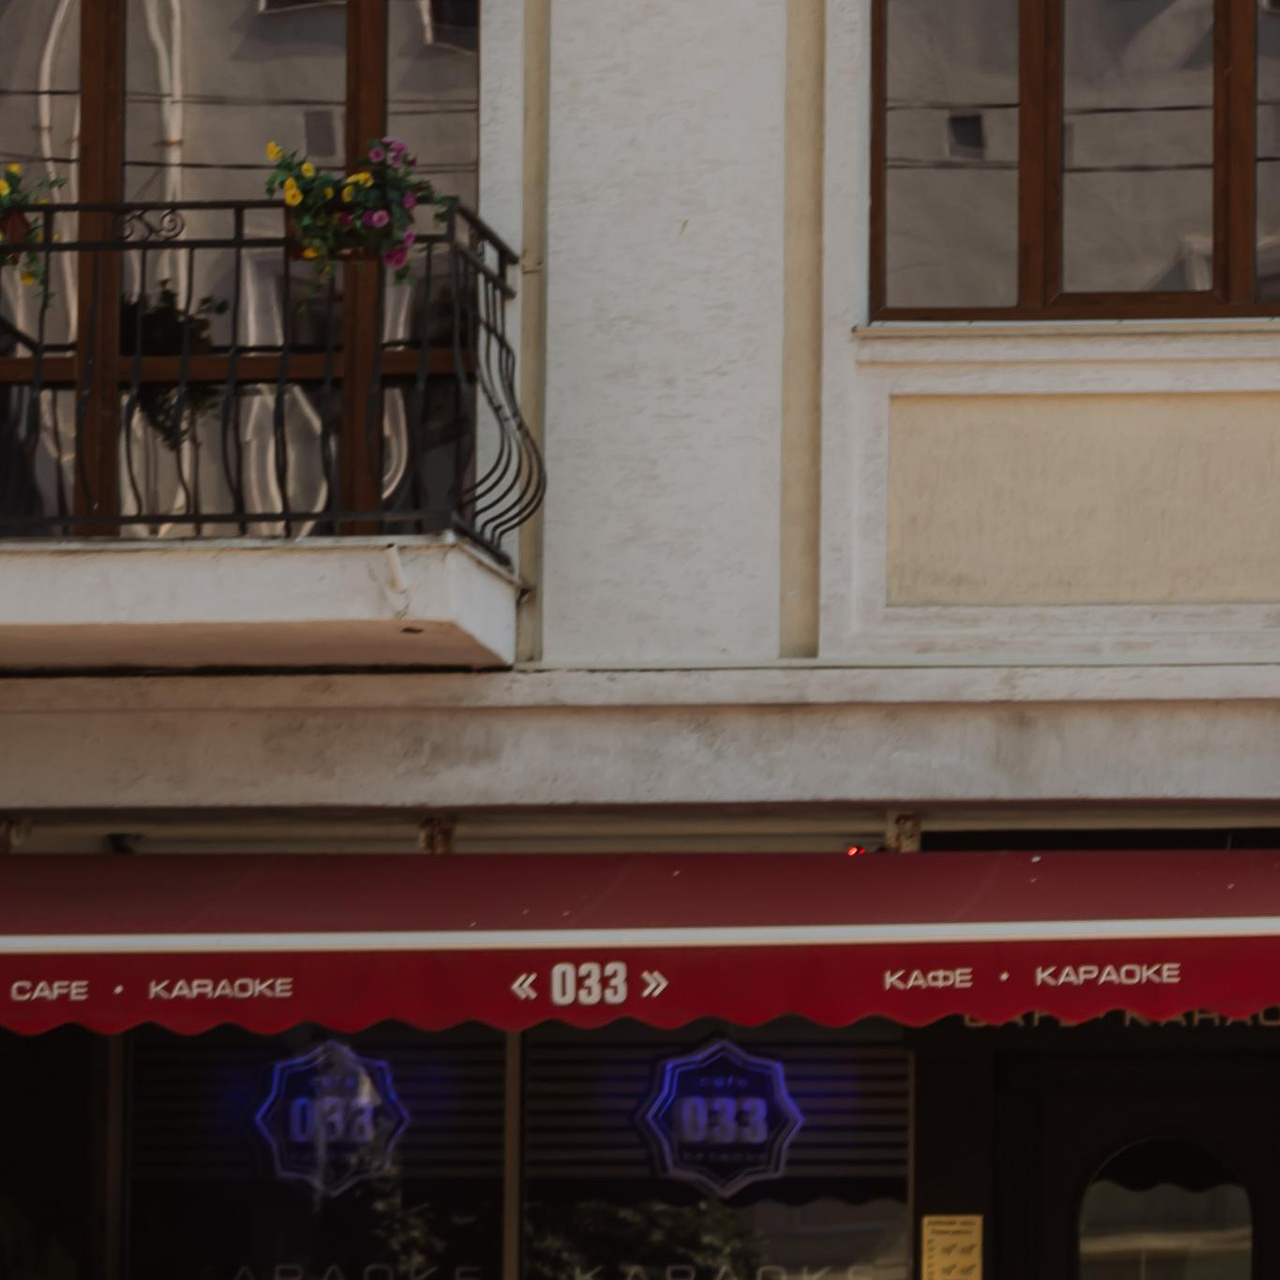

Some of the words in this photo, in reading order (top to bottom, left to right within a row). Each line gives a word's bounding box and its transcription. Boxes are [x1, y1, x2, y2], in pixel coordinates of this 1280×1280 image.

[10, 979, 90, 1002] CAFE
[148, 976, 294, 1000] KARAOKE
[883, 966, 974, 991] КАФЕ
[1034, 962, 1182, 988] КАРАОКЕ
[679, 1095, 768, 1144] 033
